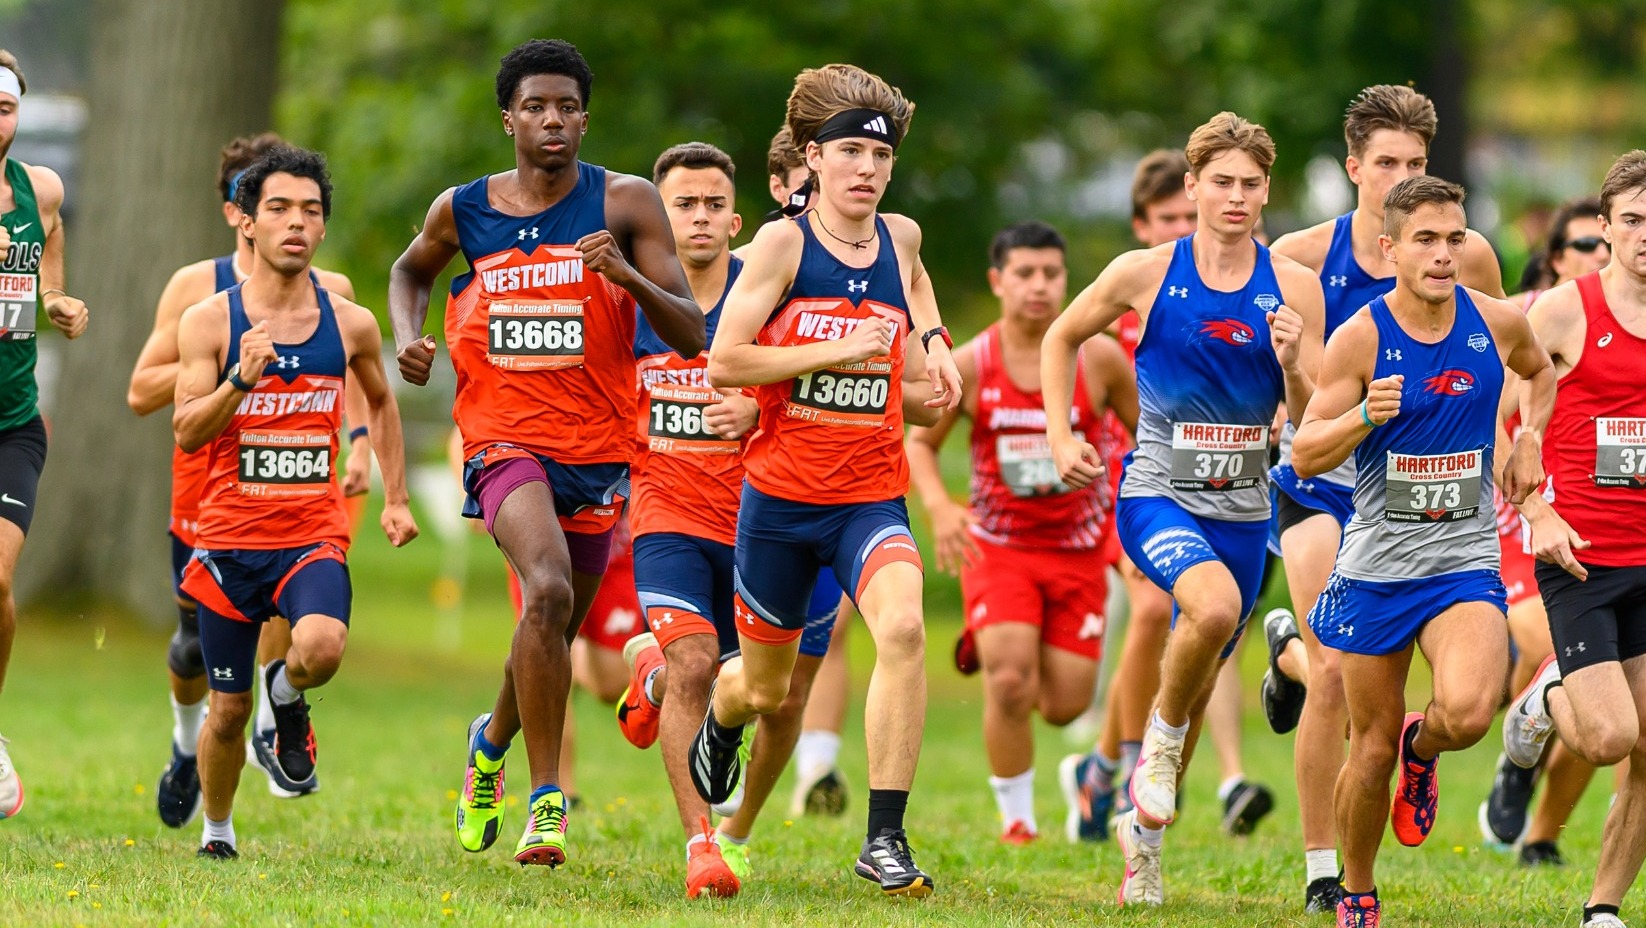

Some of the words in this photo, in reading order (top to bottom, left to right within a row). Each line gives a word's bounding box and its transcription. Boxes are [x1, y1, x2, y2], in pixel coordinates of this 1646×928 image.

[482, 259, 583, 293] WESTCONN
[513, 303, 551, 314] Accurate
[553, 303, 582, 314] Timing
[490, 320, 582, 349] 13668
[797, 311, 899, 347] WESTN
[492, 357, 515, 368] FAT
[867, 362, 891, 373] Timing
[673, 388, 709, 400] Accurate
[798, 373, 888, 408] 13660
[791, 406, 820, 421] FAT
[241, 433, 267, 443] Fulton
[268, 434, 305, 444] Accurate
[306, 434, 331, 445] Timing
[1183, 424, 1262, 442] HARTFORD
[649, 439, 675, 451] FAT
[241, 449, 329, 478] 13664
[1194, 453, 1243, 478] 370
[1396, 453, 1475, 473] HARTFORD
[1620, 448, 1646, 474] 37
[1433, 472, 1462, 480] Country
[242, 484, 268, 496] FAT
[1410, 482, 1460, 510] 373
